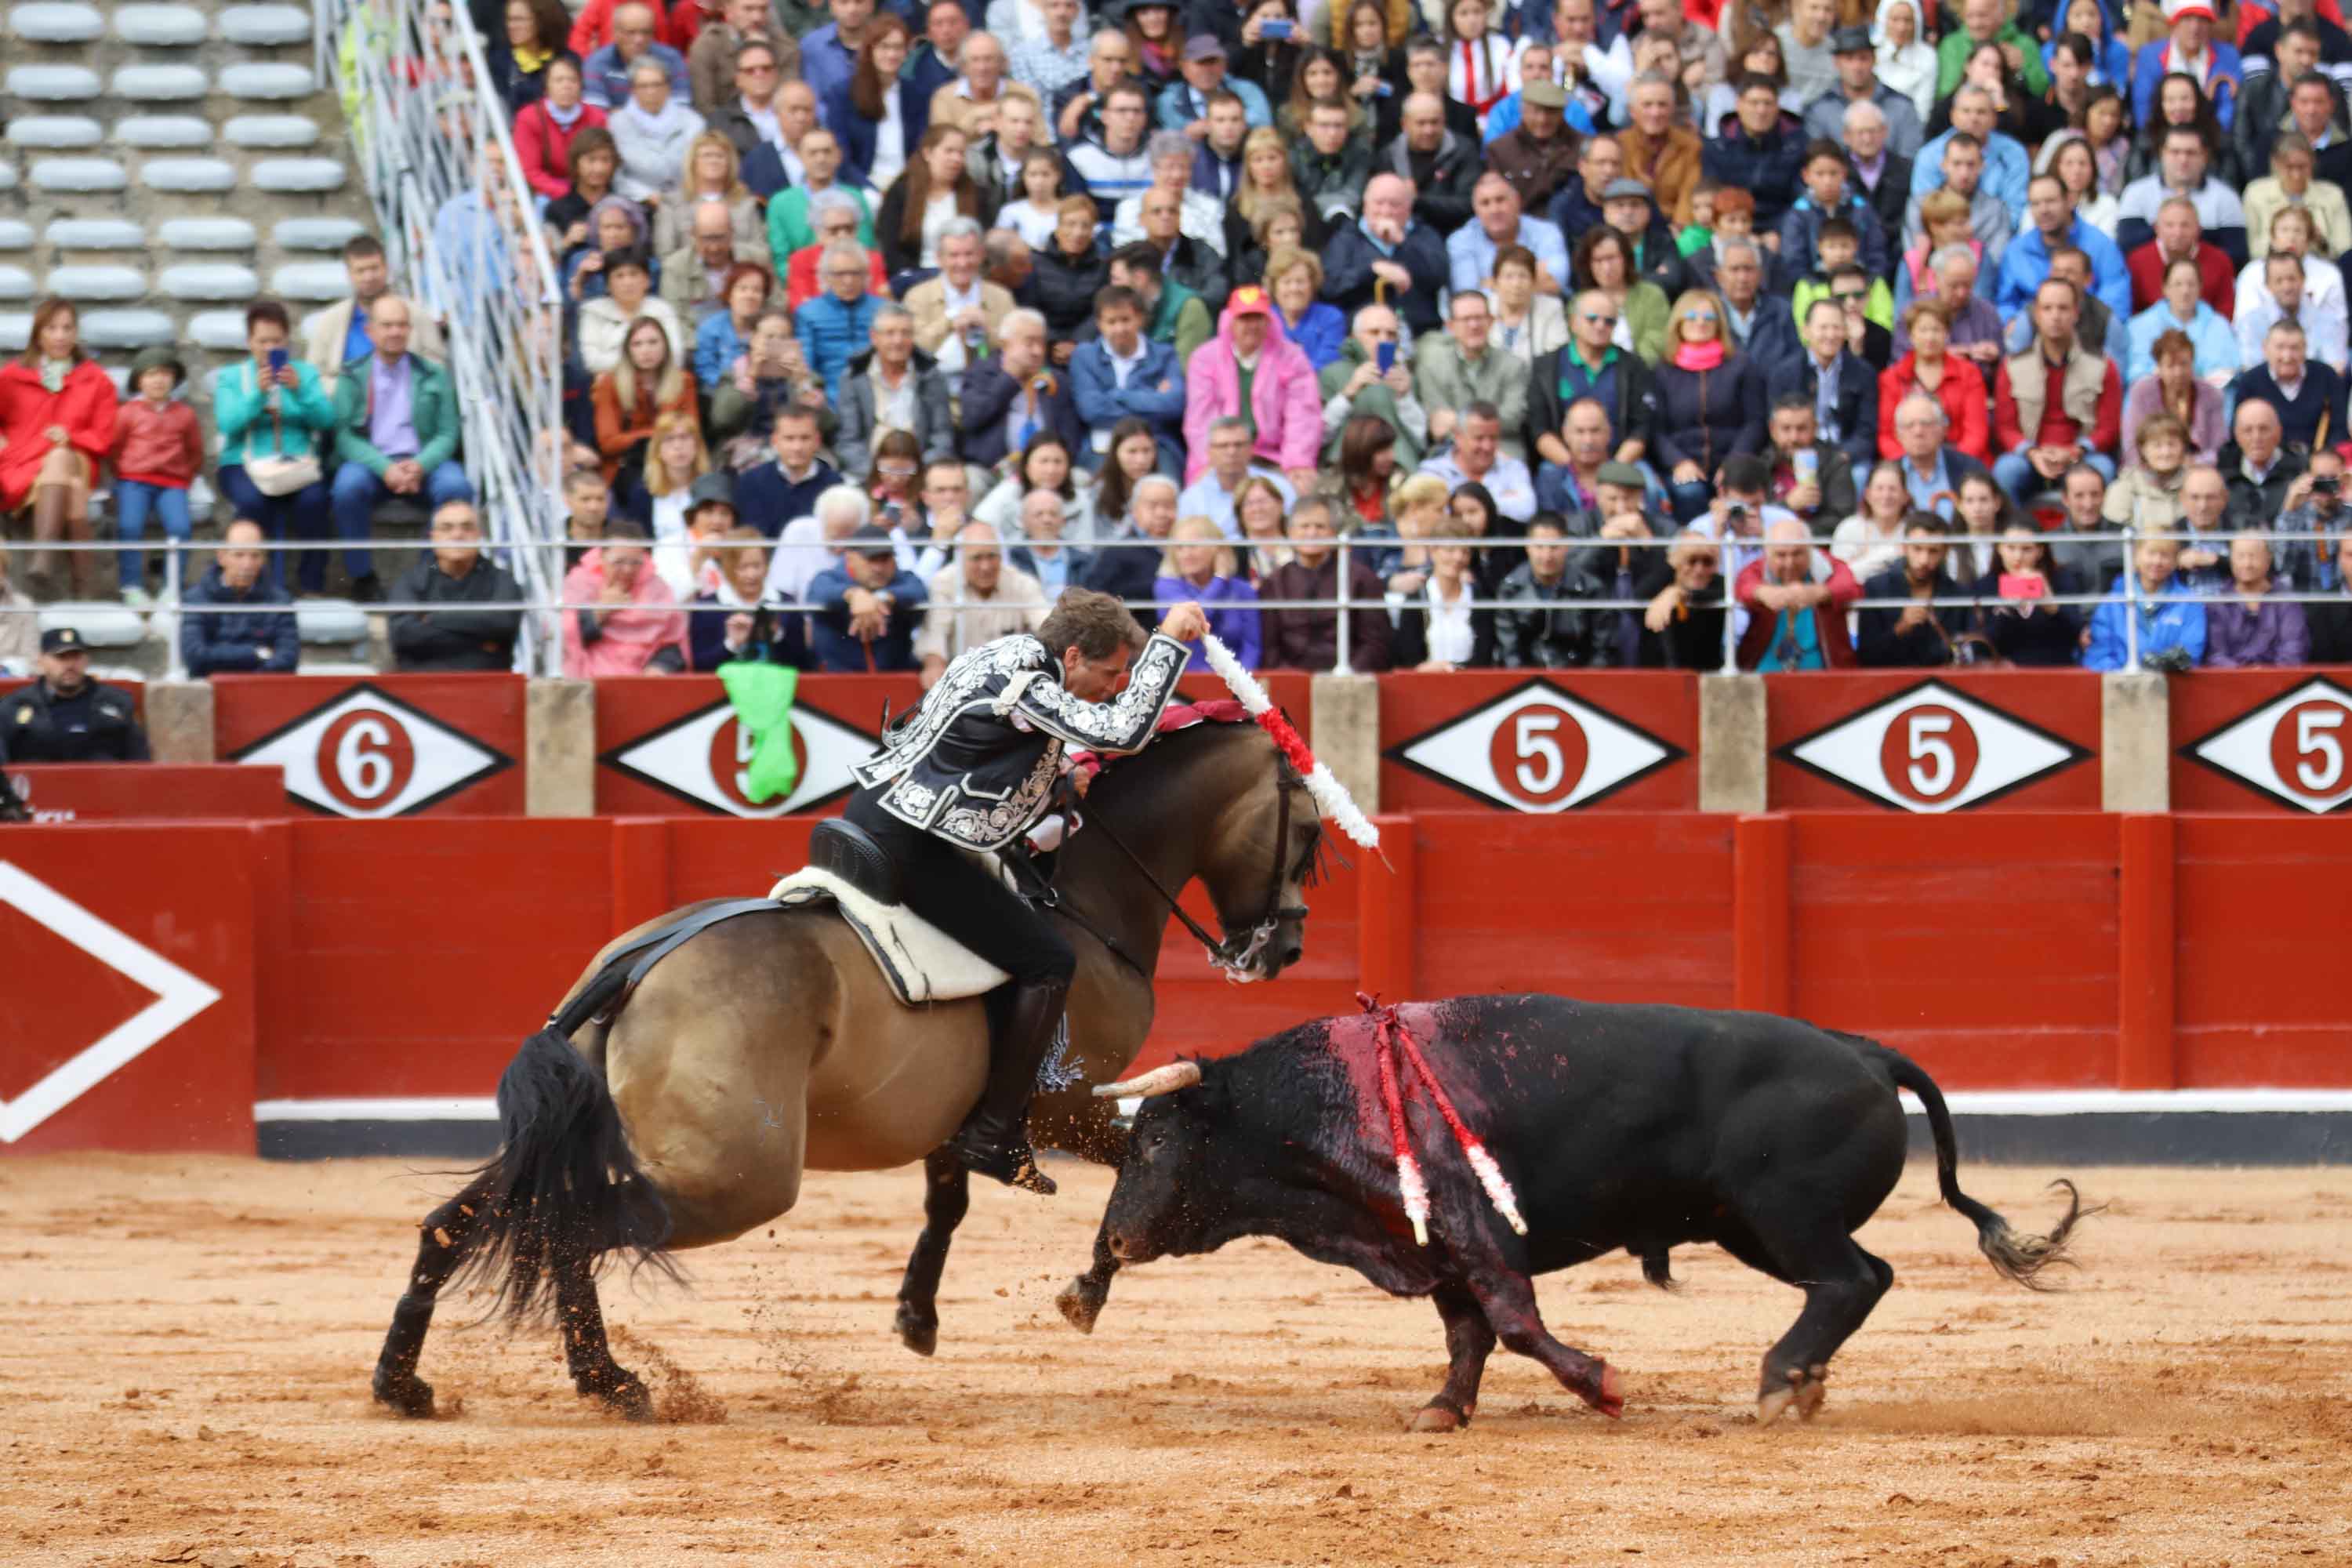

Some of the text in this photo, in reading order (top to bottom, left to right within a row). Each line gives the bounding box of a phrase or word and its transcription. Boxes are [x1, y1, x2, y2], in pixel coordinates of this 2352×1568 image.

[337, 719, 393, 799] 6
[1516, 714, 1564, 793] 5
[1908, 715, 1955, 796] 5
[2297, 710, 2344, 790] 5
